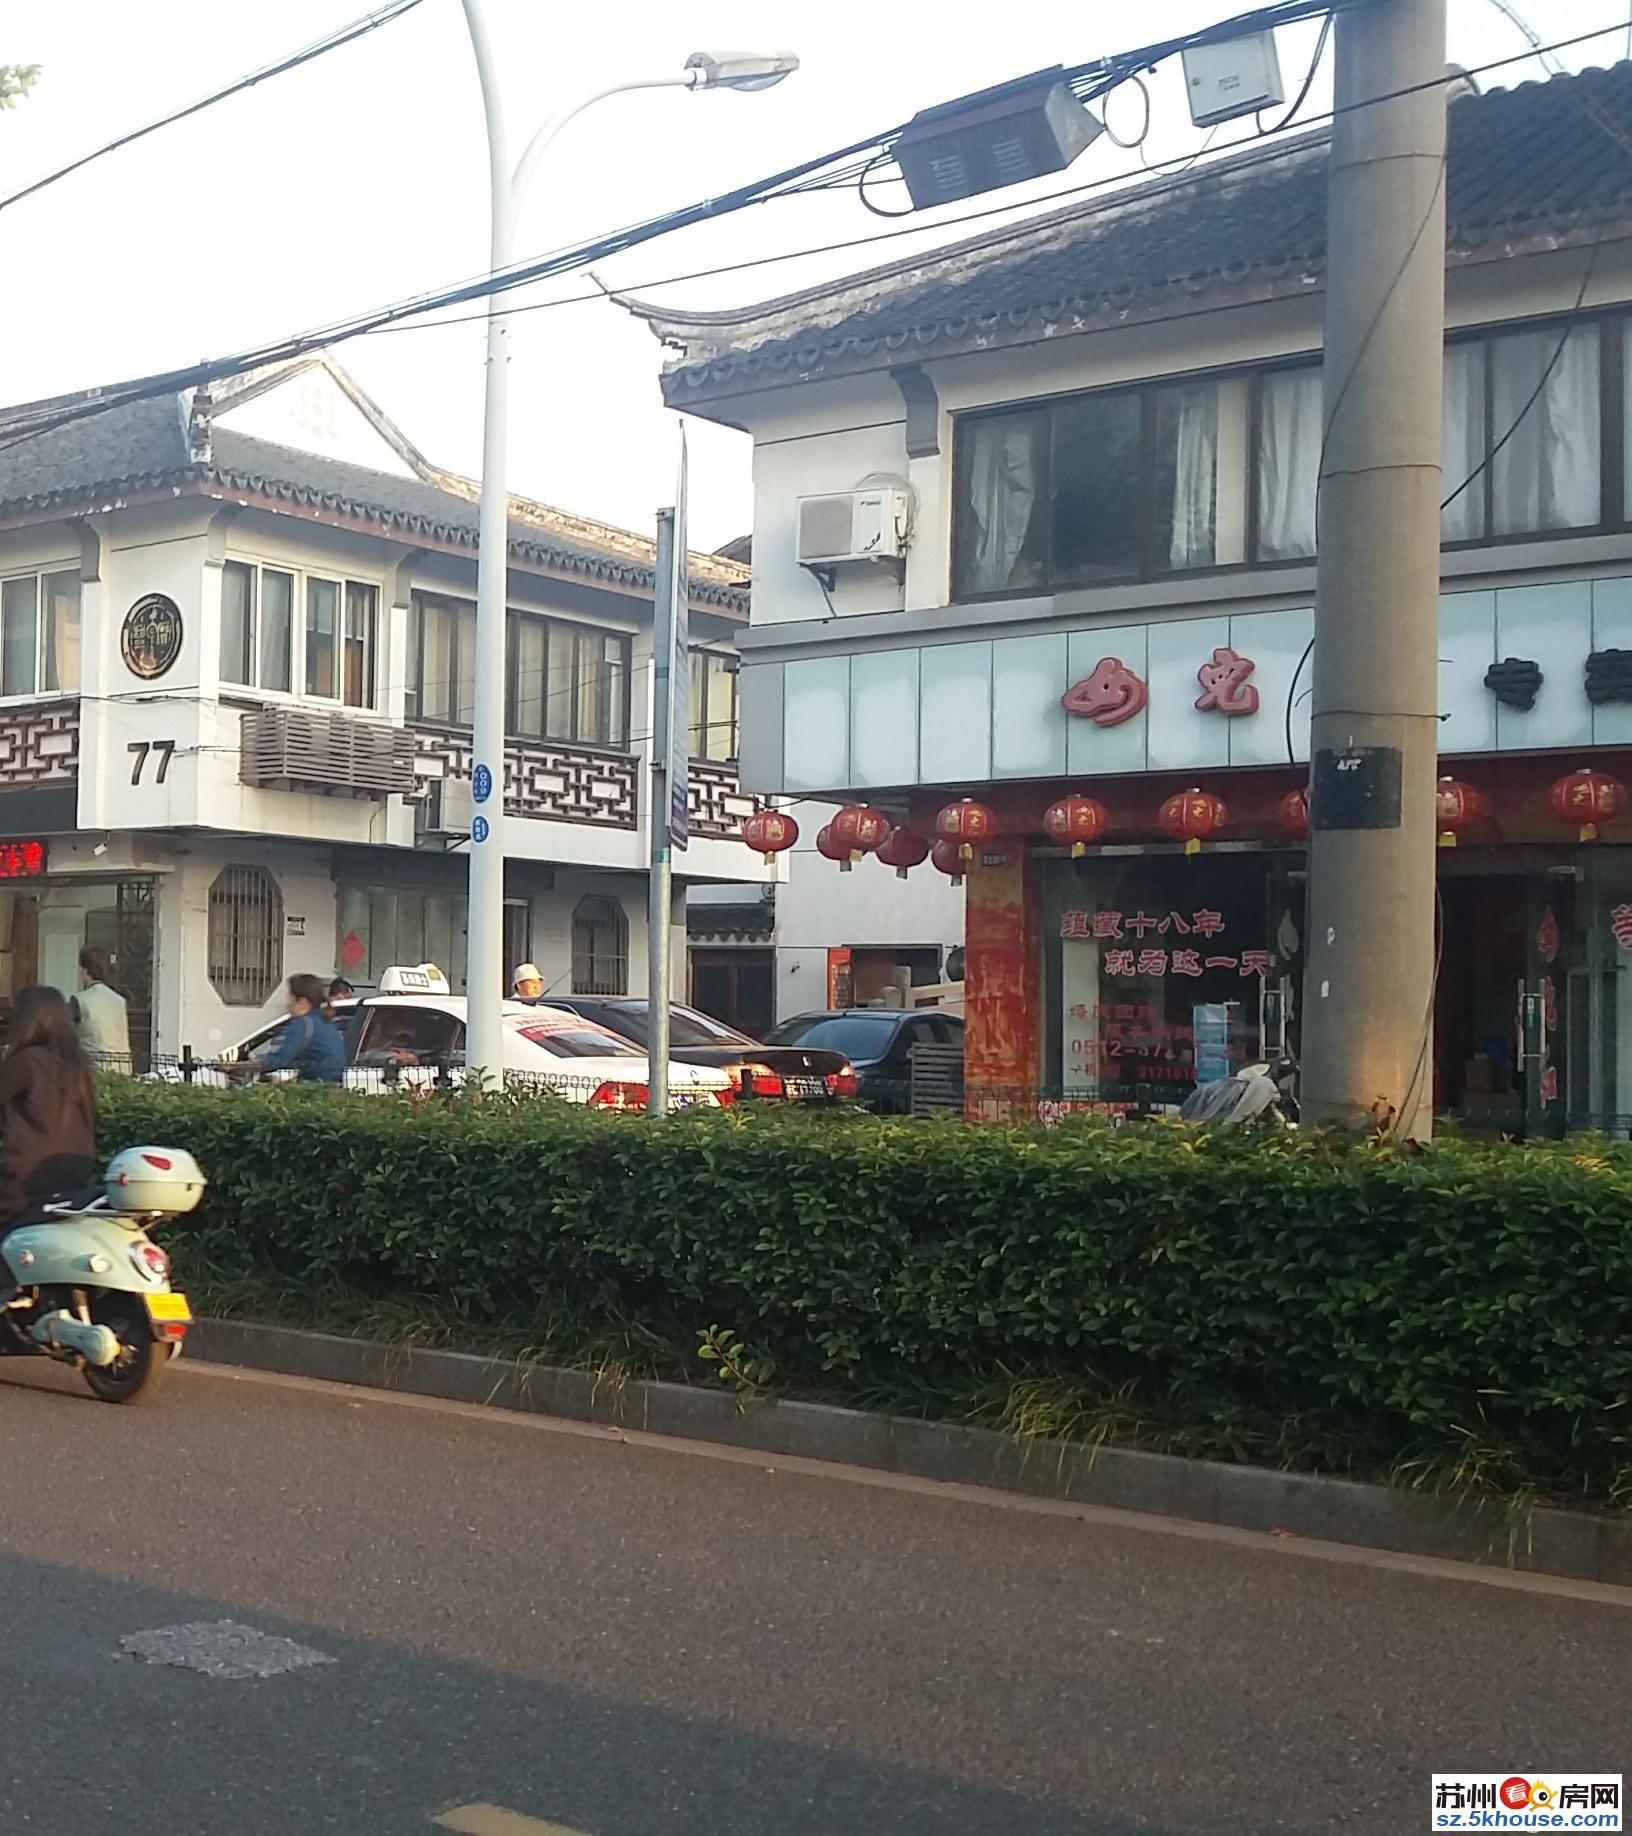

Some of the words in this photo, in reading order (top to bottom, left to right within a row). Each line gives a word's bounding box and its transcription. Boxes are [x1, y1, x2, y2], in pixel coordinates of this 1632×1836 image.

[127, 740, 175, 786] 77
[1104, 949, 1272, 978] 就为这一天
